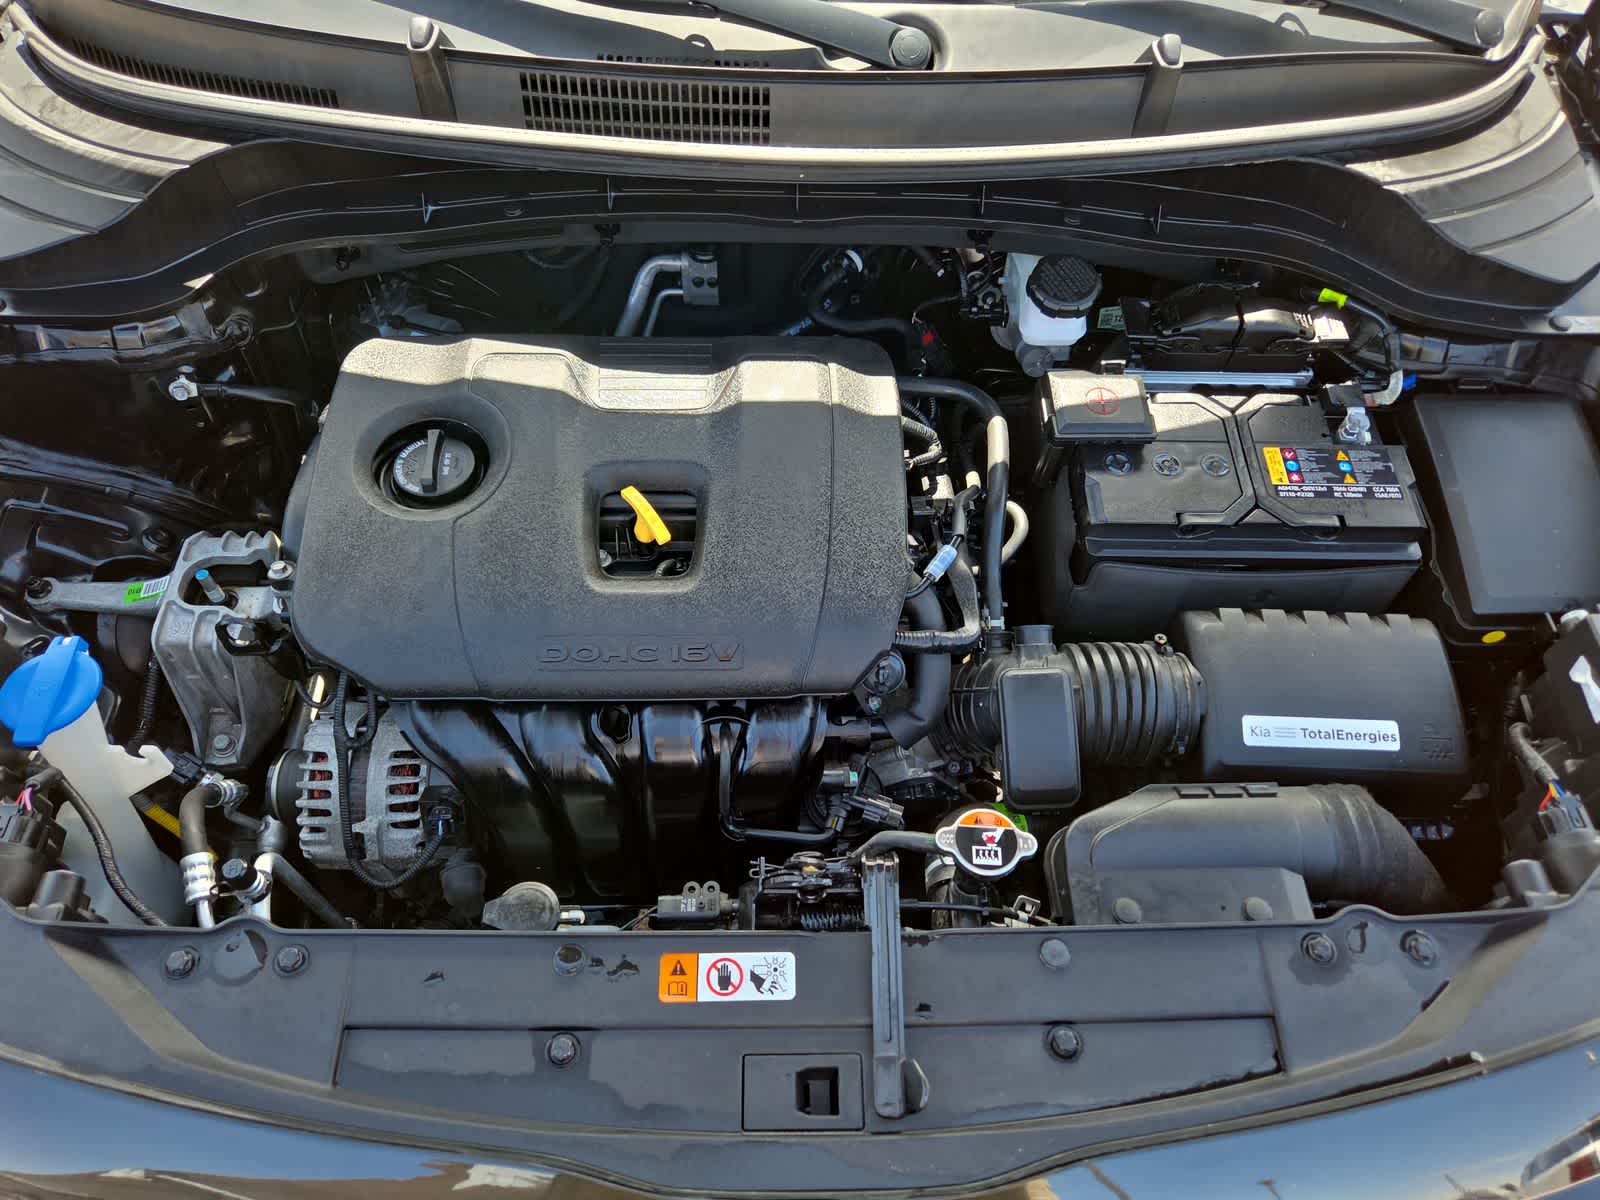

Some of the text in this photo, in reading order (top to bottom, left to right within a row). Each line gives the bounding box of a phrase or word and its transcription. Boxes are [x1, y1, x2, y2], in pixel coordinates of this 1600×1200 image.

[540, 643, 741, 663] DOHC 16V
[1250, 726, 1397, 743] Kia TotalEnergies
